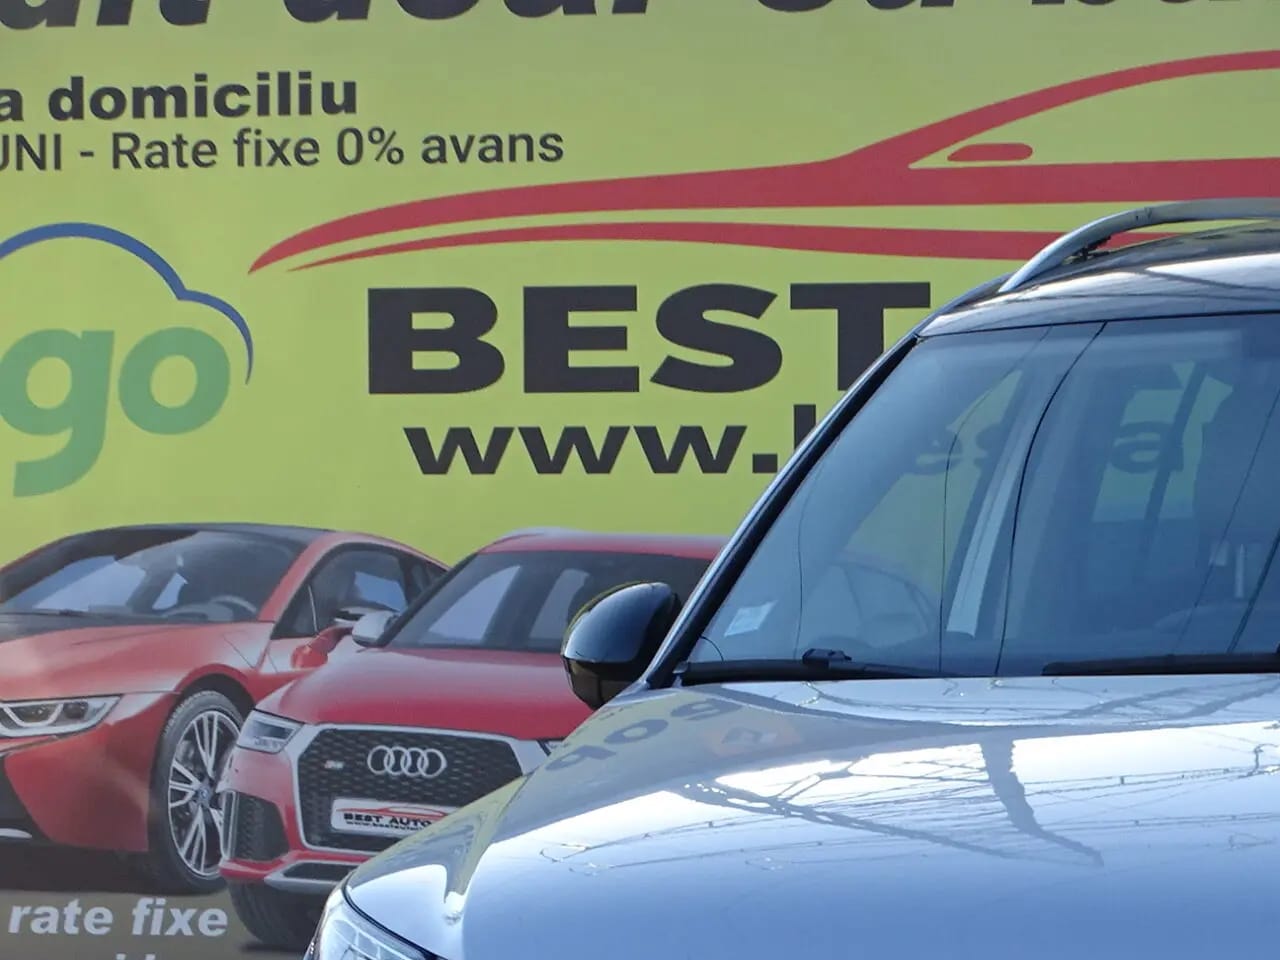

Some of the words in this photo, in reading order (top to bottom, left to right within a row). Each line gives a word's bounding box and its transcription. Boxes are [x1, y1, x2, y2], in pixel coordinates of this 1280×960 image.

[48, 72, 357, 121] domiciliu
[112, 132, 217, 170] Rate
[233, 128, 320, 168] fixe
[337, 127, 404, 166] 0%
[421, 131, 564, 165] avans
[367, 282, 930, 394] BEST
[344, 813, 384, 823] BEST
[8, 898, 113, 935] rate
[132, 897, 228, 937] fixe
